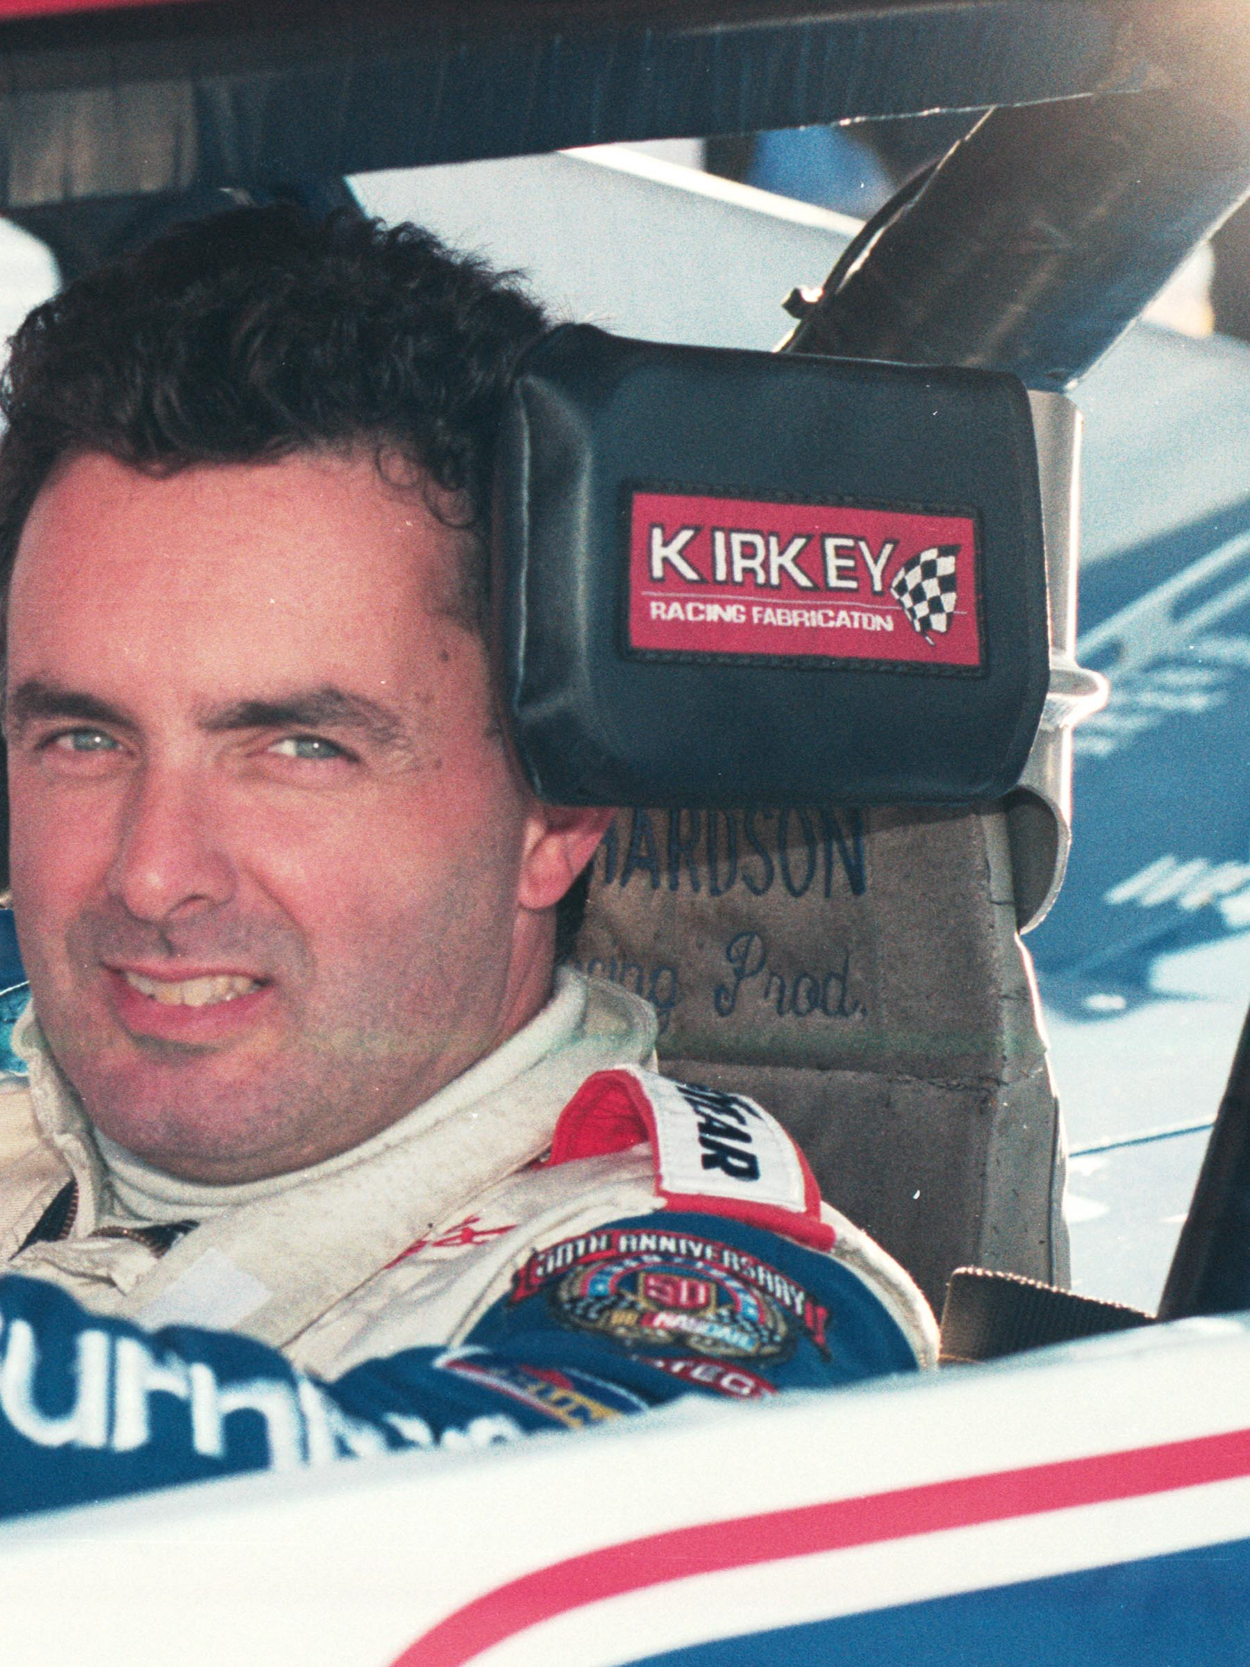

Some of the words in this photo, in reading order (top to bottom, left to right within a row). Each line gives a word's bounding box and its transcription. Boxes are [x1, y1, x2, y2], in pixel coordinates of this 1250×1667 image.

[649, 524, 897, 594] KIRKEY
[649, 600, 747, 624] RACING
[713, 931, 868, 1018] Prod.
[618, 1233, 806, 1316] ANNIVERSARY
